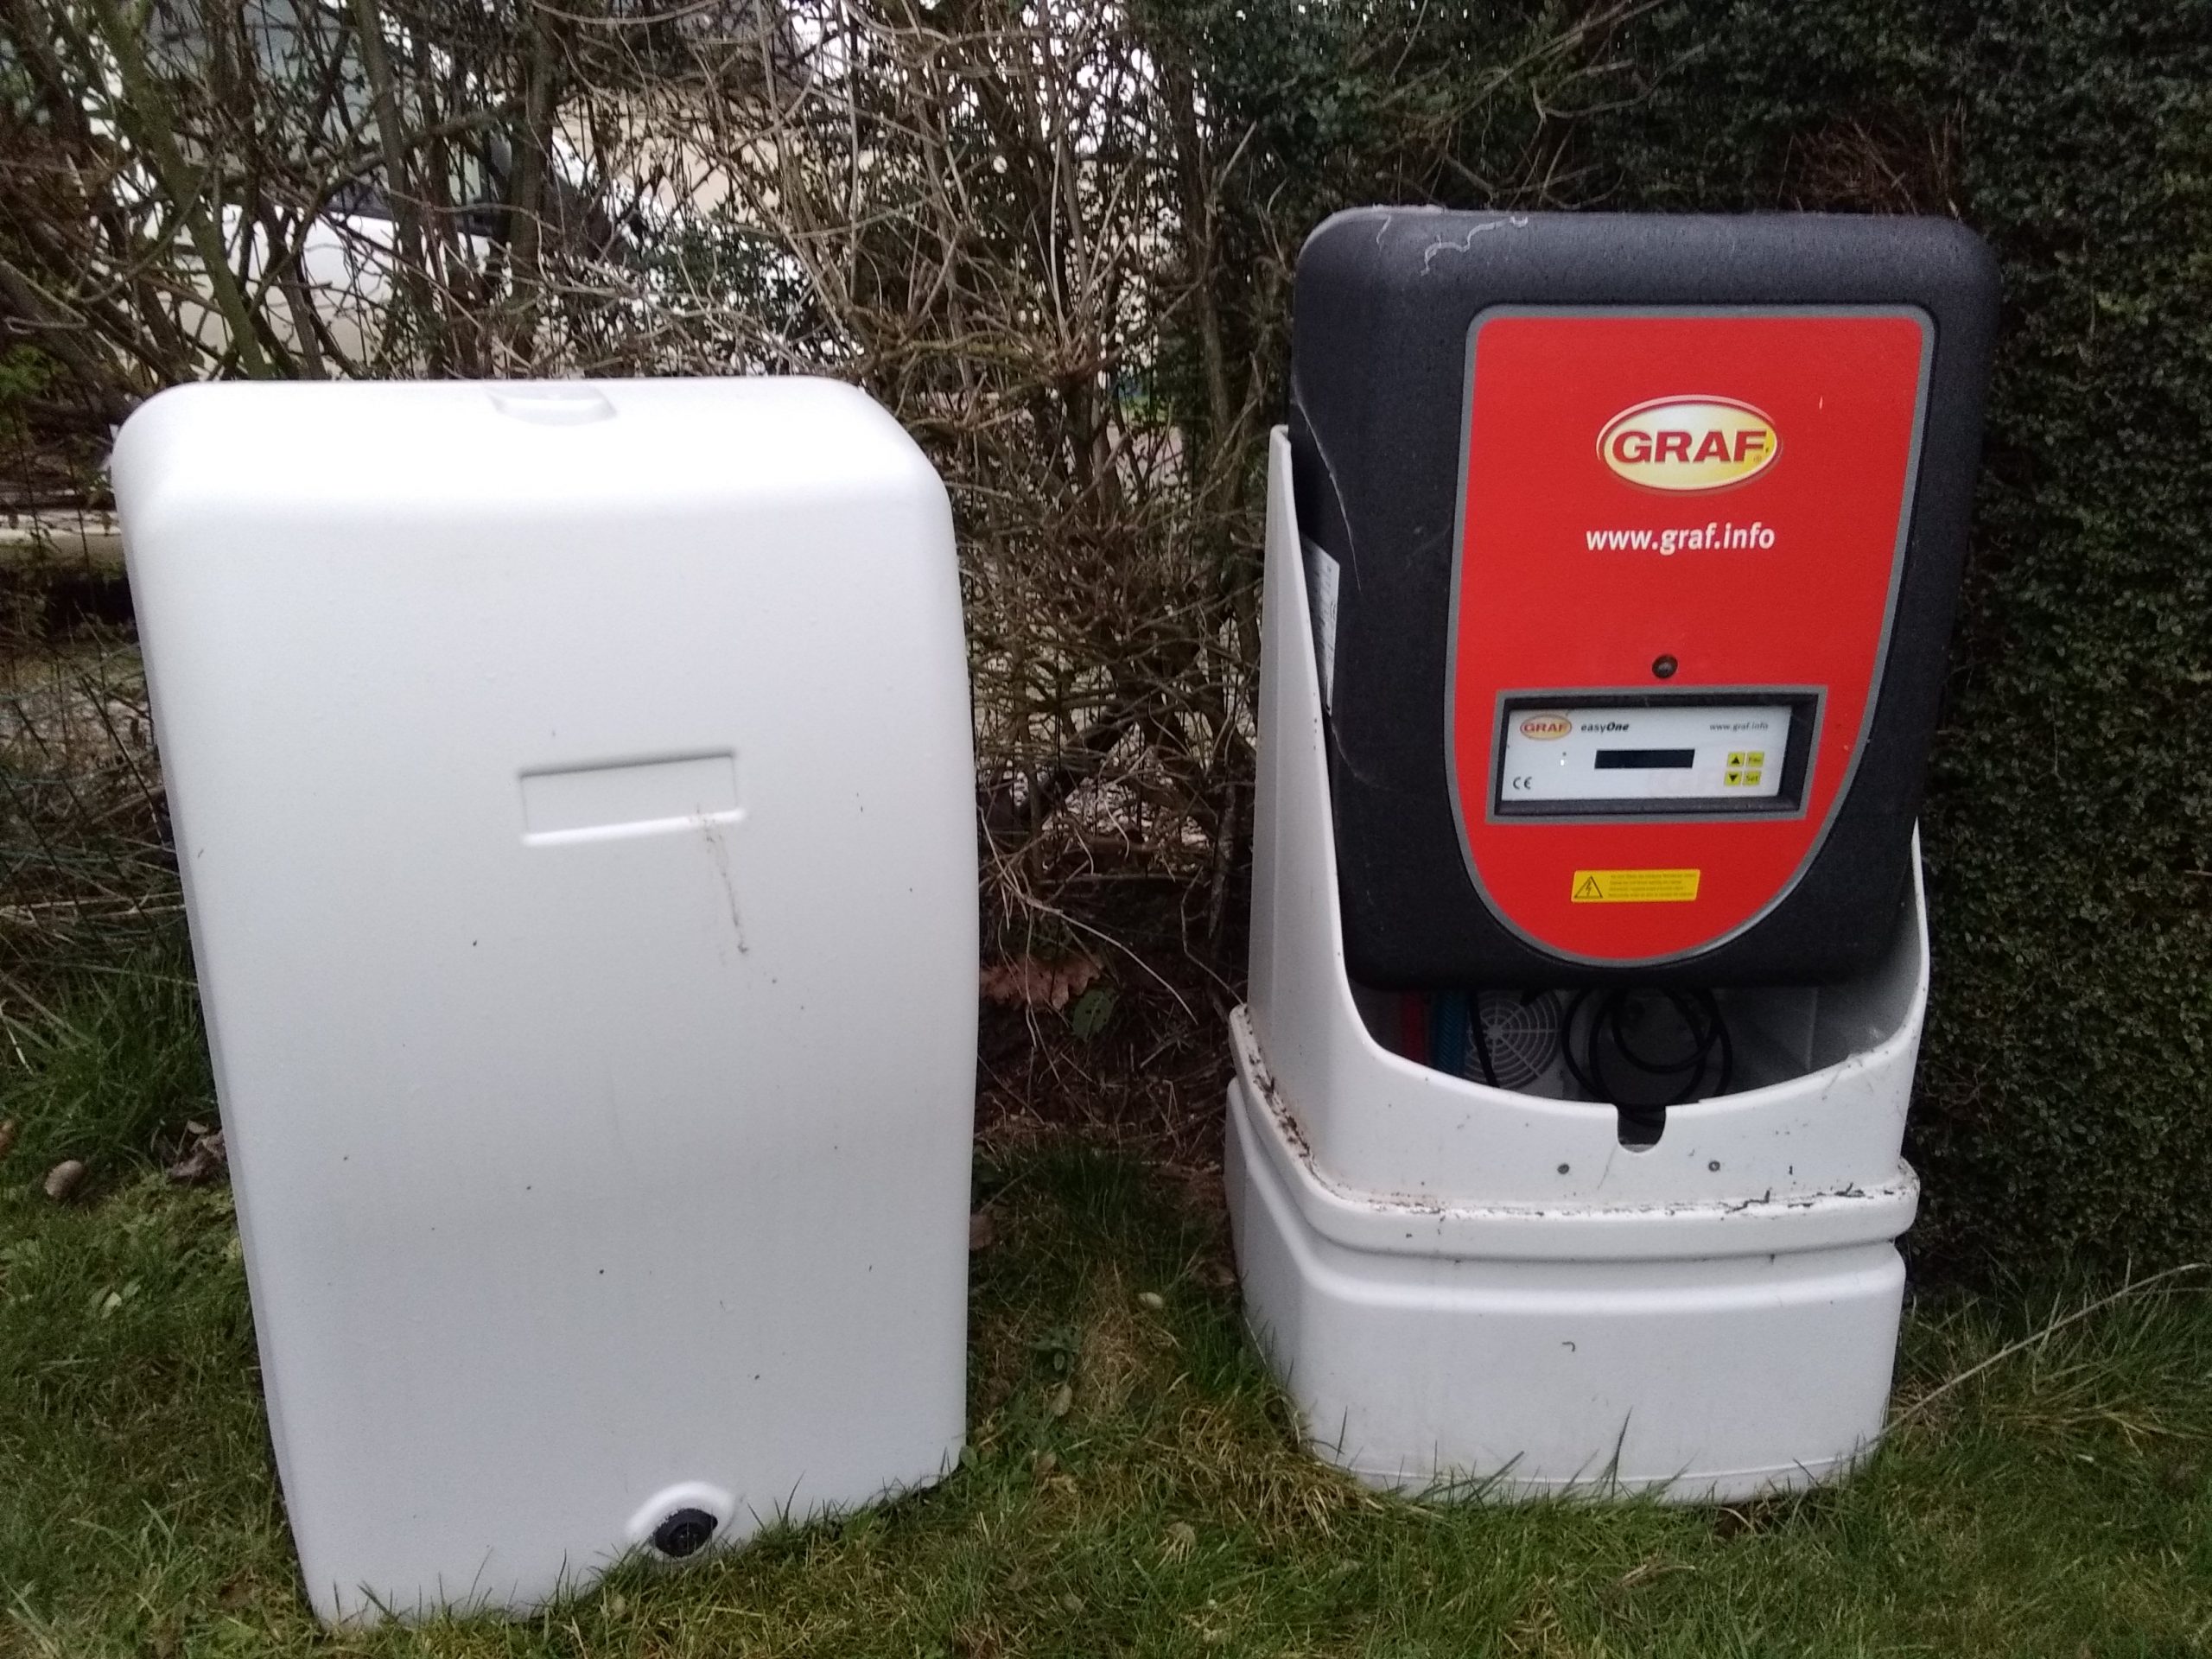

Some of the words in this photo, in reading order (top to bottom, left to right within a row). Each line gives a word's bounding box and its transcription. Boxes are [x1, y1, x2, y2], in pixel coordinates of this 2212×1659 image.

[1612, 429, 1767, 463] GRAF
[1586, 521, 1775, 556] www.graf.info
[1523, 723, 1568, 733] GRAF
[1580, 721, 1630, 733] easyOne
[1709, 721, 1769, 732] www.graf.info
